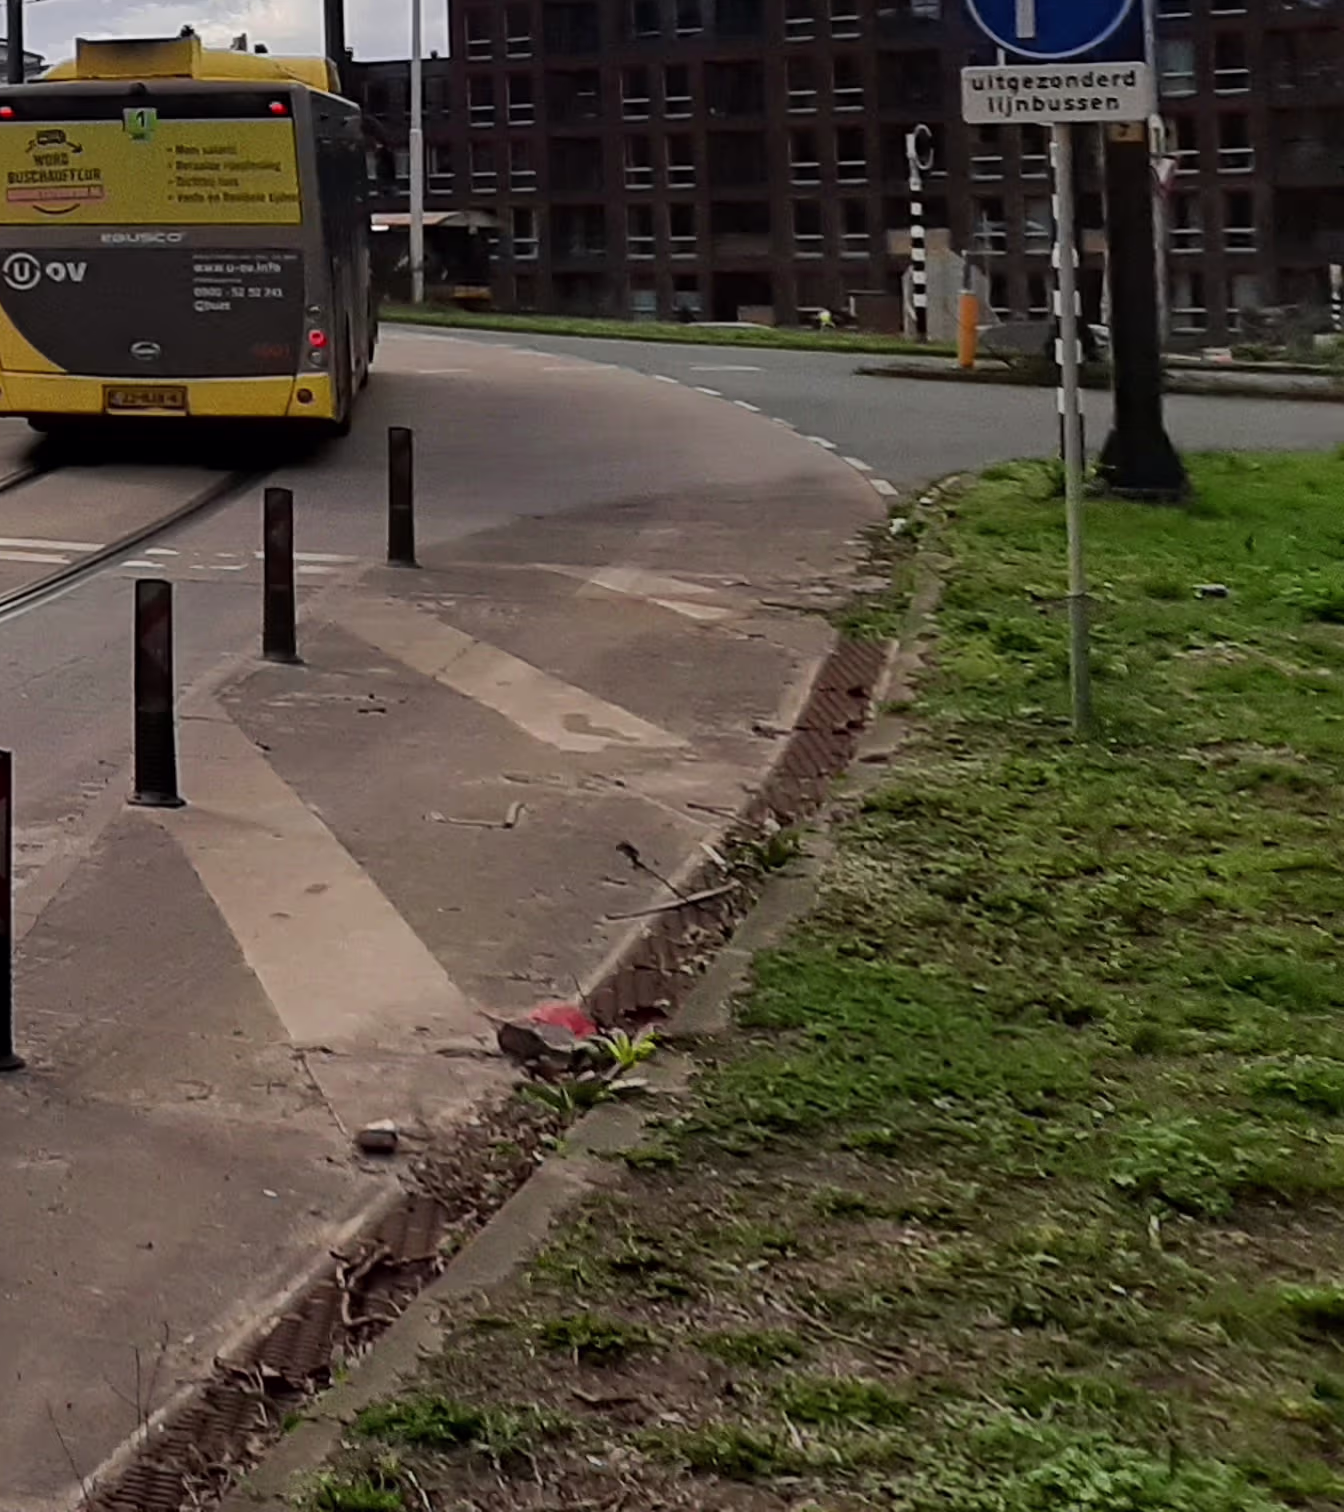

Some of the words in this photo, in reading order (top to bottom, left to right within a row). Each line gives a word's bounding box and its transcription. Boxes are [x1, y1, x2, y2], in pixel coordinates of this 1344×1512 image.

[971, 69, 1137, 94] uitgezonderd
[987, 95, 1120, 117] lijnbussen
[135, 110, 145, 128] 1
[45, 261, 88, 282] OV
